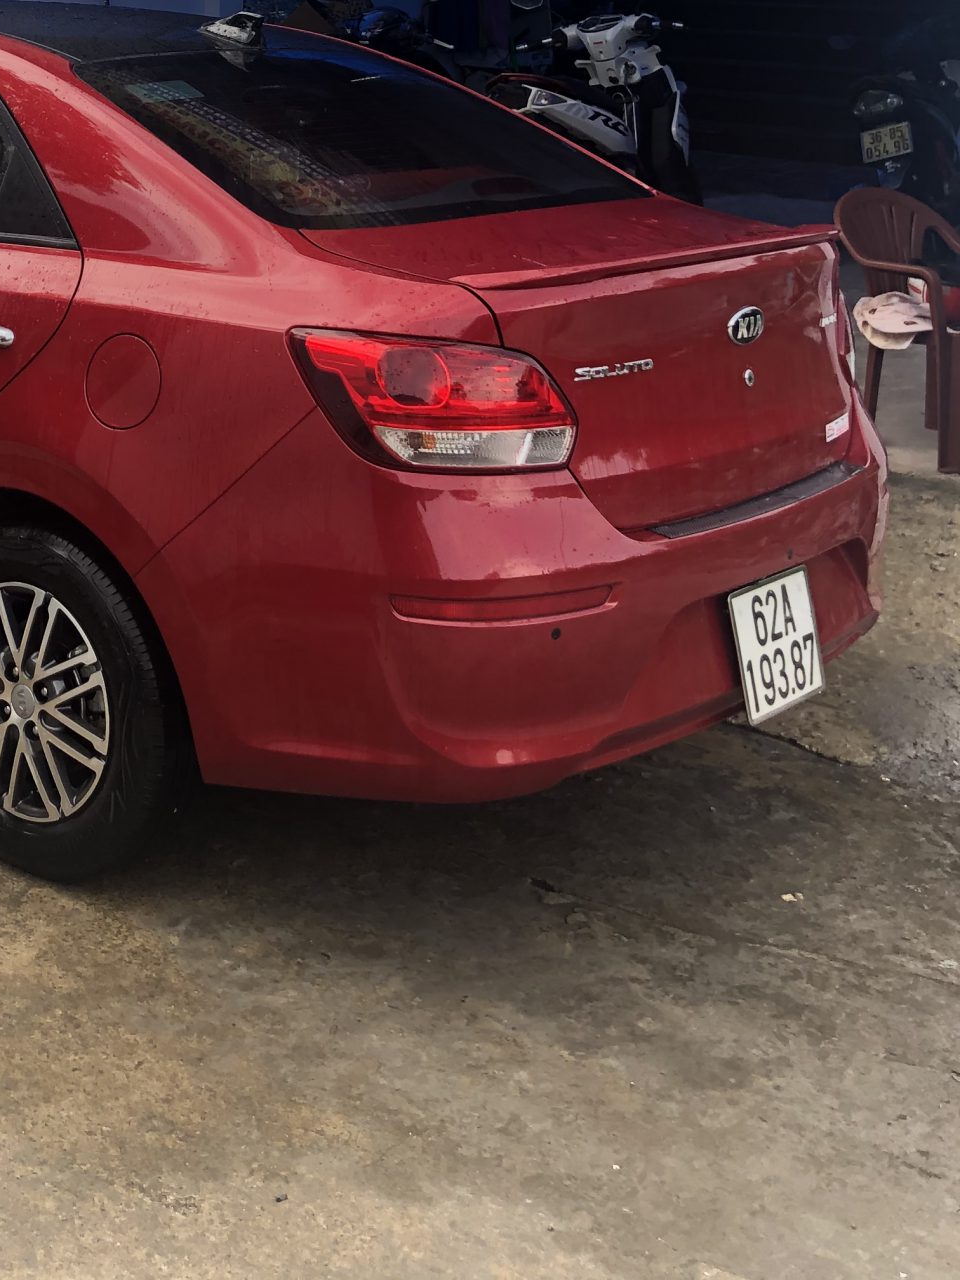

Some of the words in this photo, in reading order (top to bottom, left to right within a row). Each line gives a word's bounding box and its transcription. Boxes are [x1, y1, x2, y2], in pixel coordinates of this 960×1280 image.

[737, 314, 762, 340] KIA
[574, 358, 654, 382] SOLUTO
[750, 583, 797, 647] 62A
[746, 633, 816, 714] 193.87
